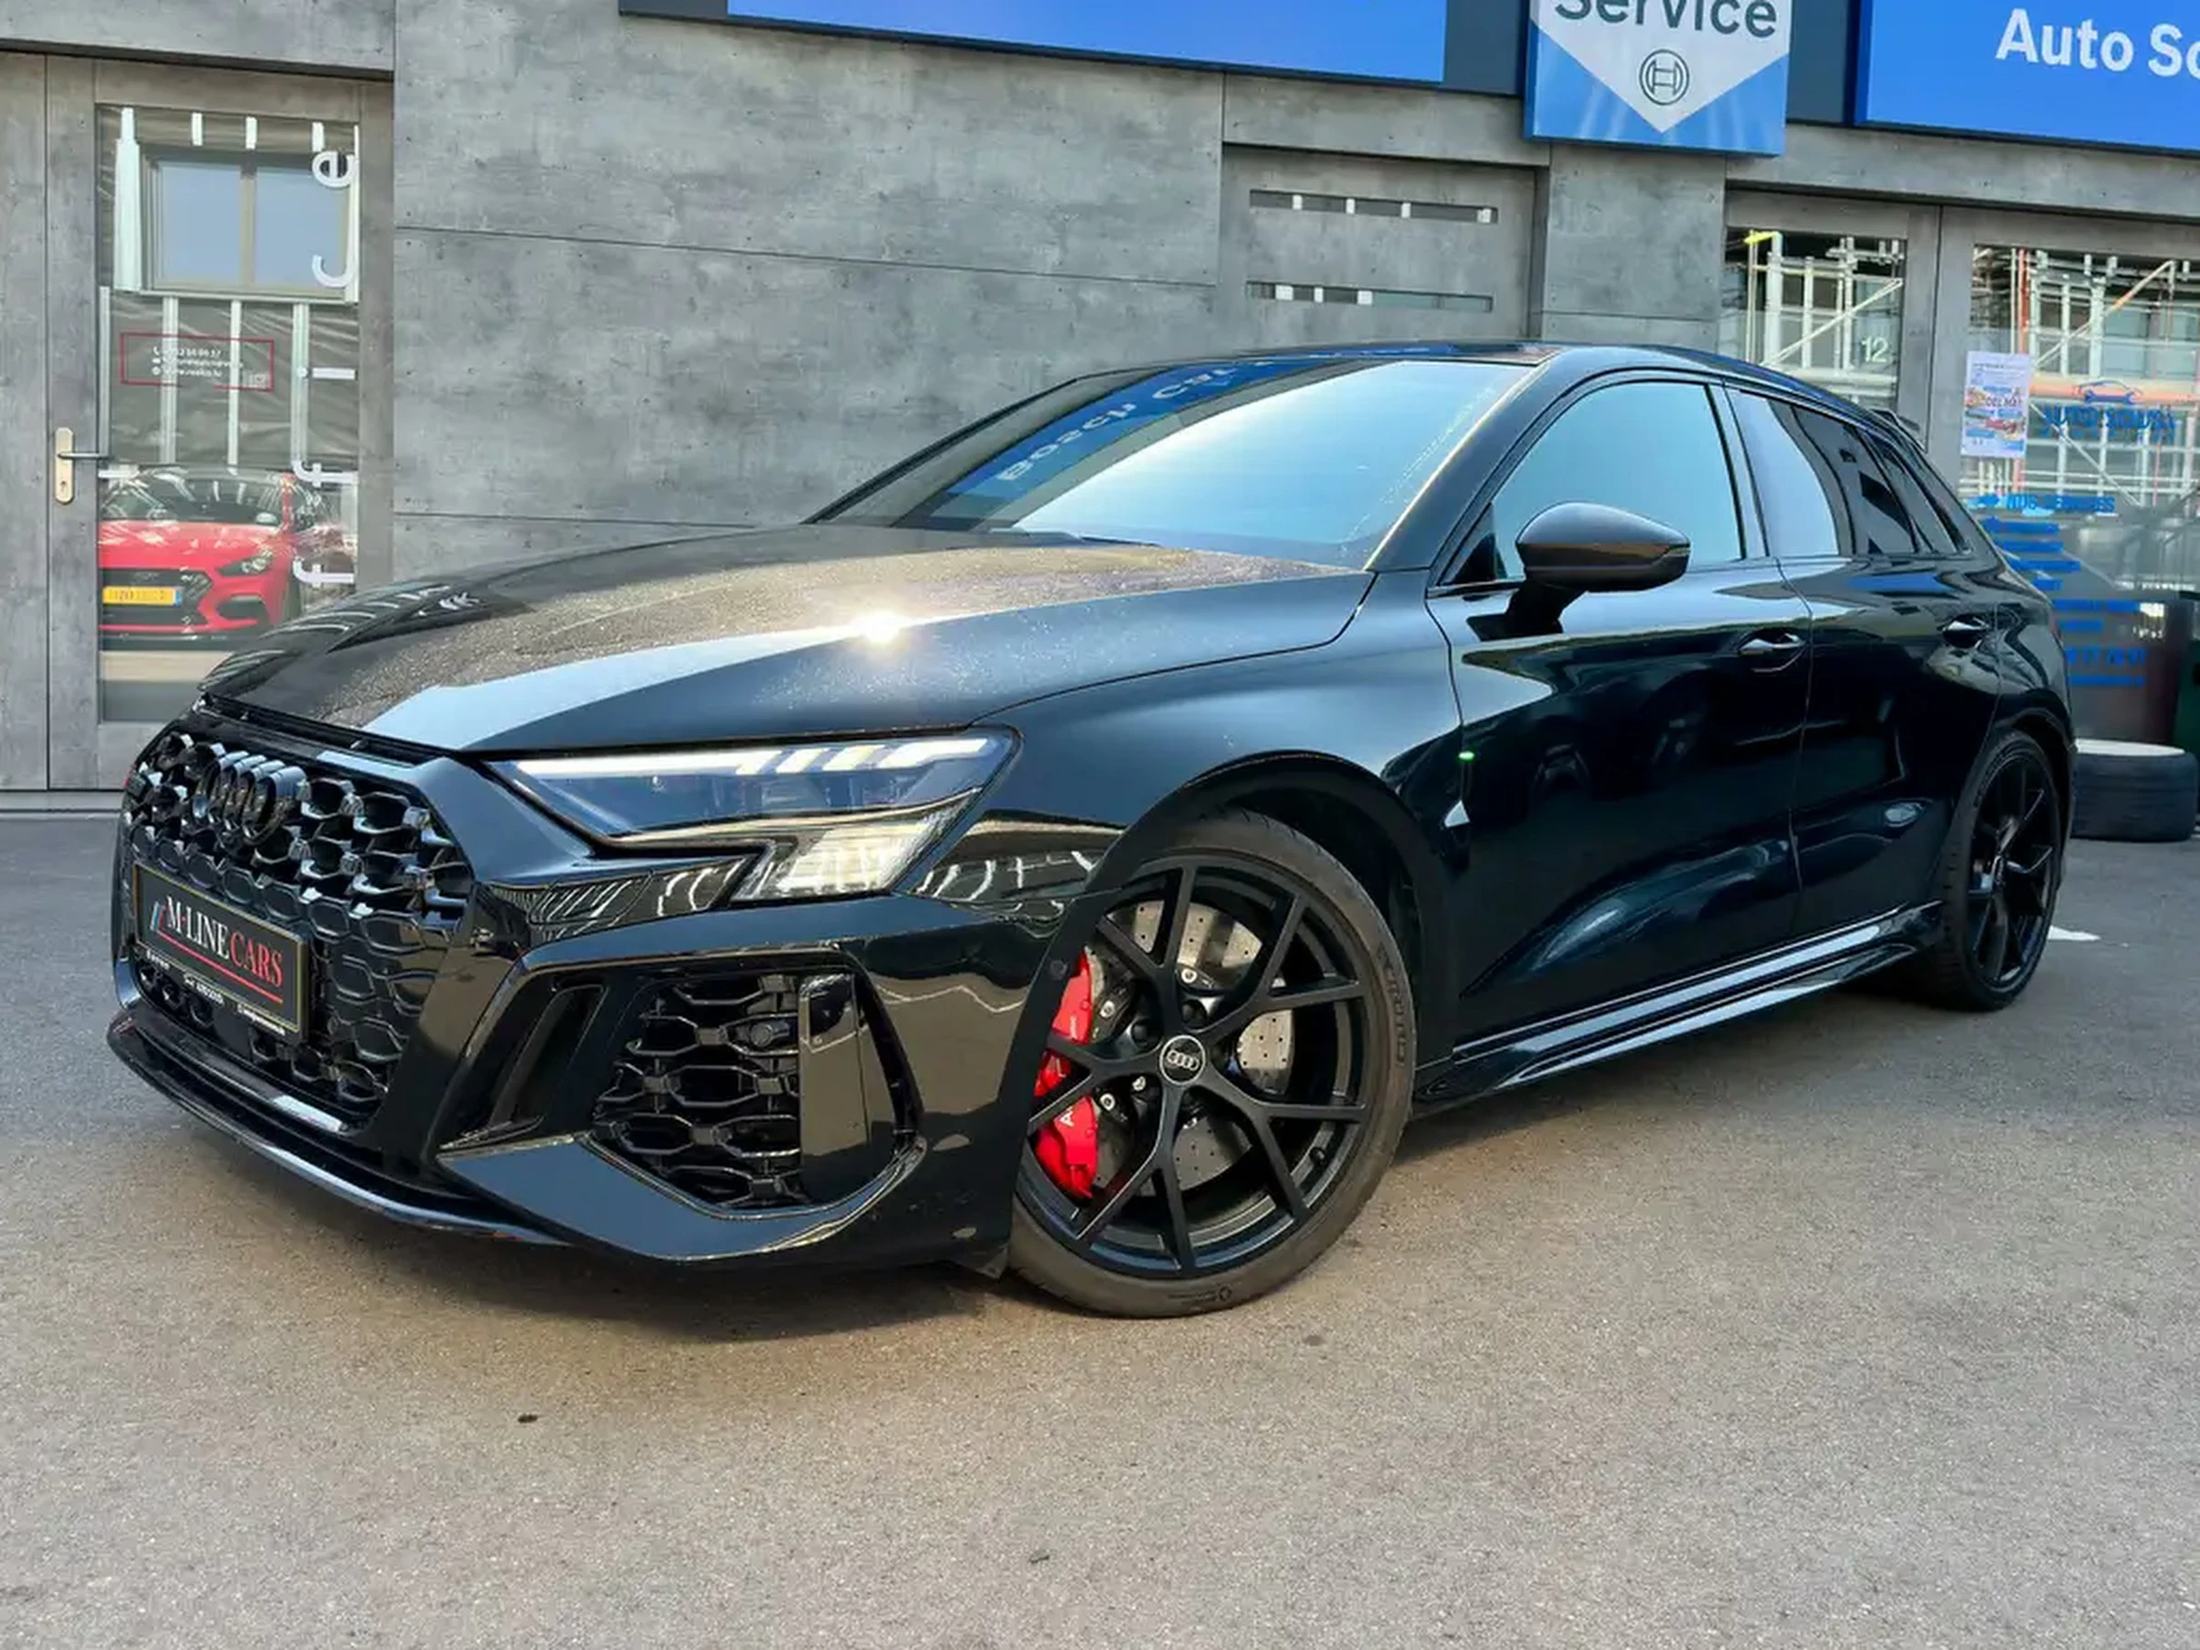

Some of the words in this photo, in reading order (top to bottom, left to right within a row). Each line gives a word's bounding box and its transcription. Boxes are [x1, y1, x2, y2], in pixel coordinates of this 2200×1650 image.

[1995, 8, 2134, 72] Auto
[292, 150, 359, 589] ffice
[1861, 336, 1888, 362] 12
